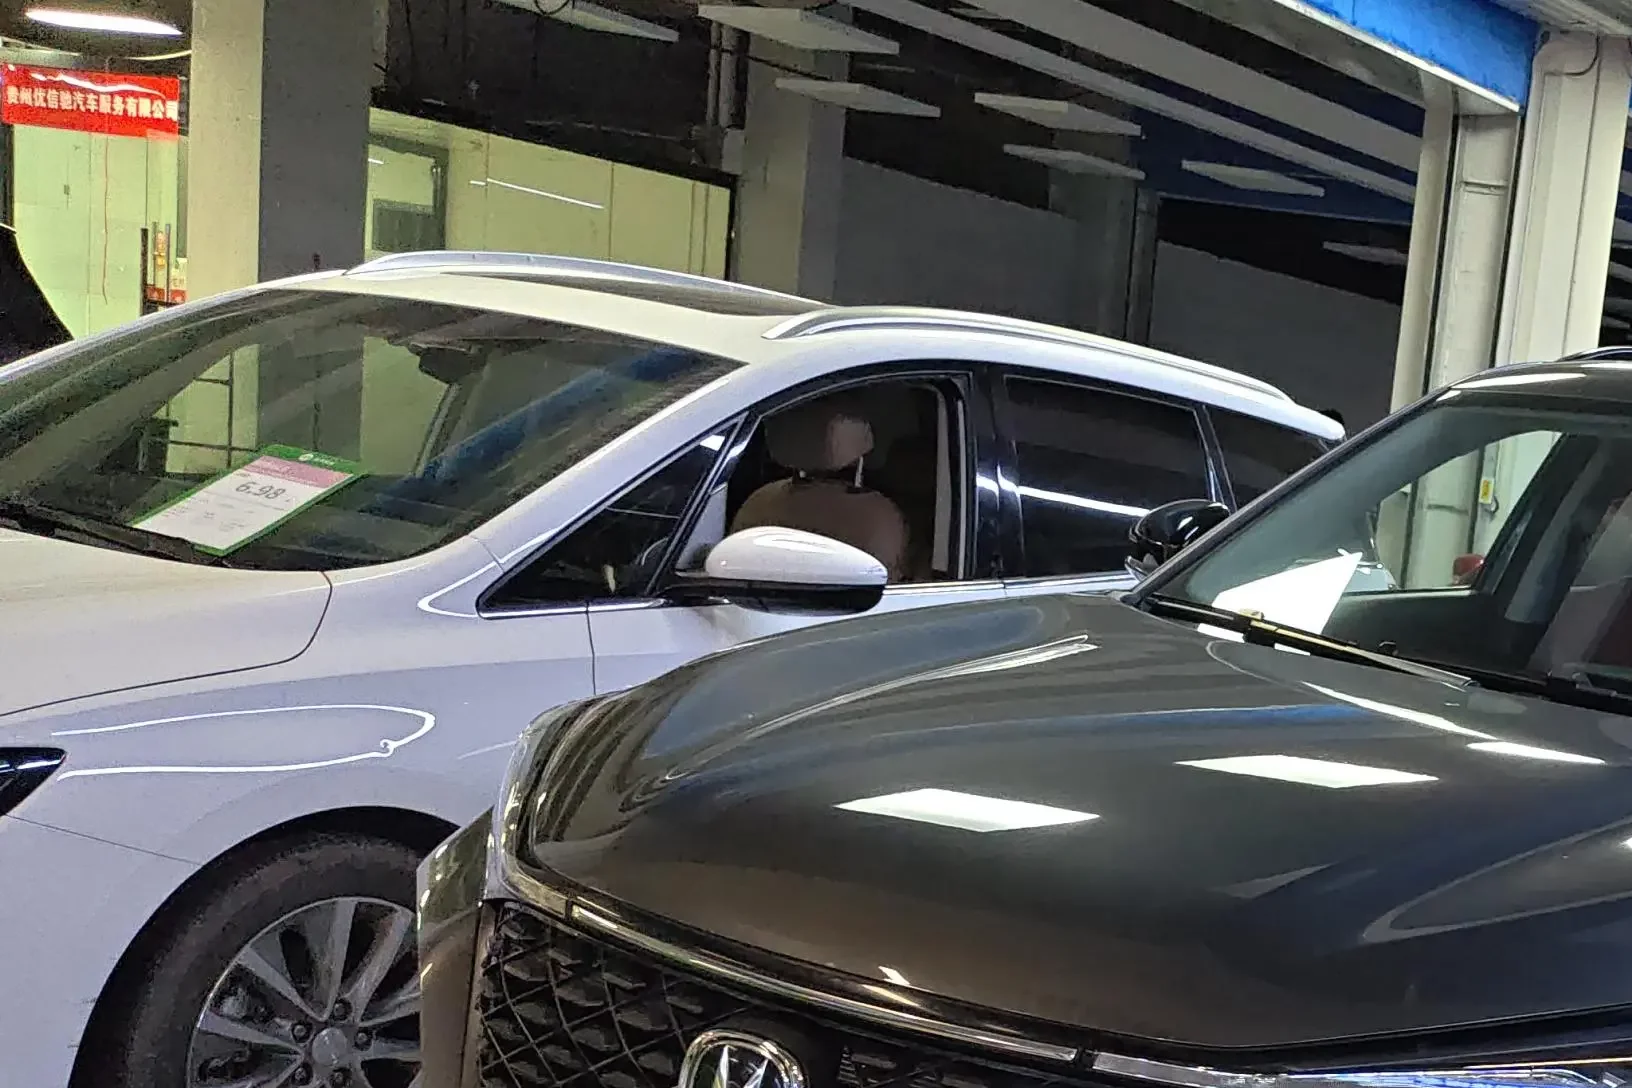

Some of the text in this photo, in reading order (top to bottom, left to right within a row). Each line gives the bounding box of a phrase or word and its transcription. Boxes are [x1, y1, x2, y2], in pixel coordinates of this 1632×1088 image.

[6, 84, 179, 122] 贵州优信驰汽车服务有限公司
[235, 481, 286, 499] 6.98
